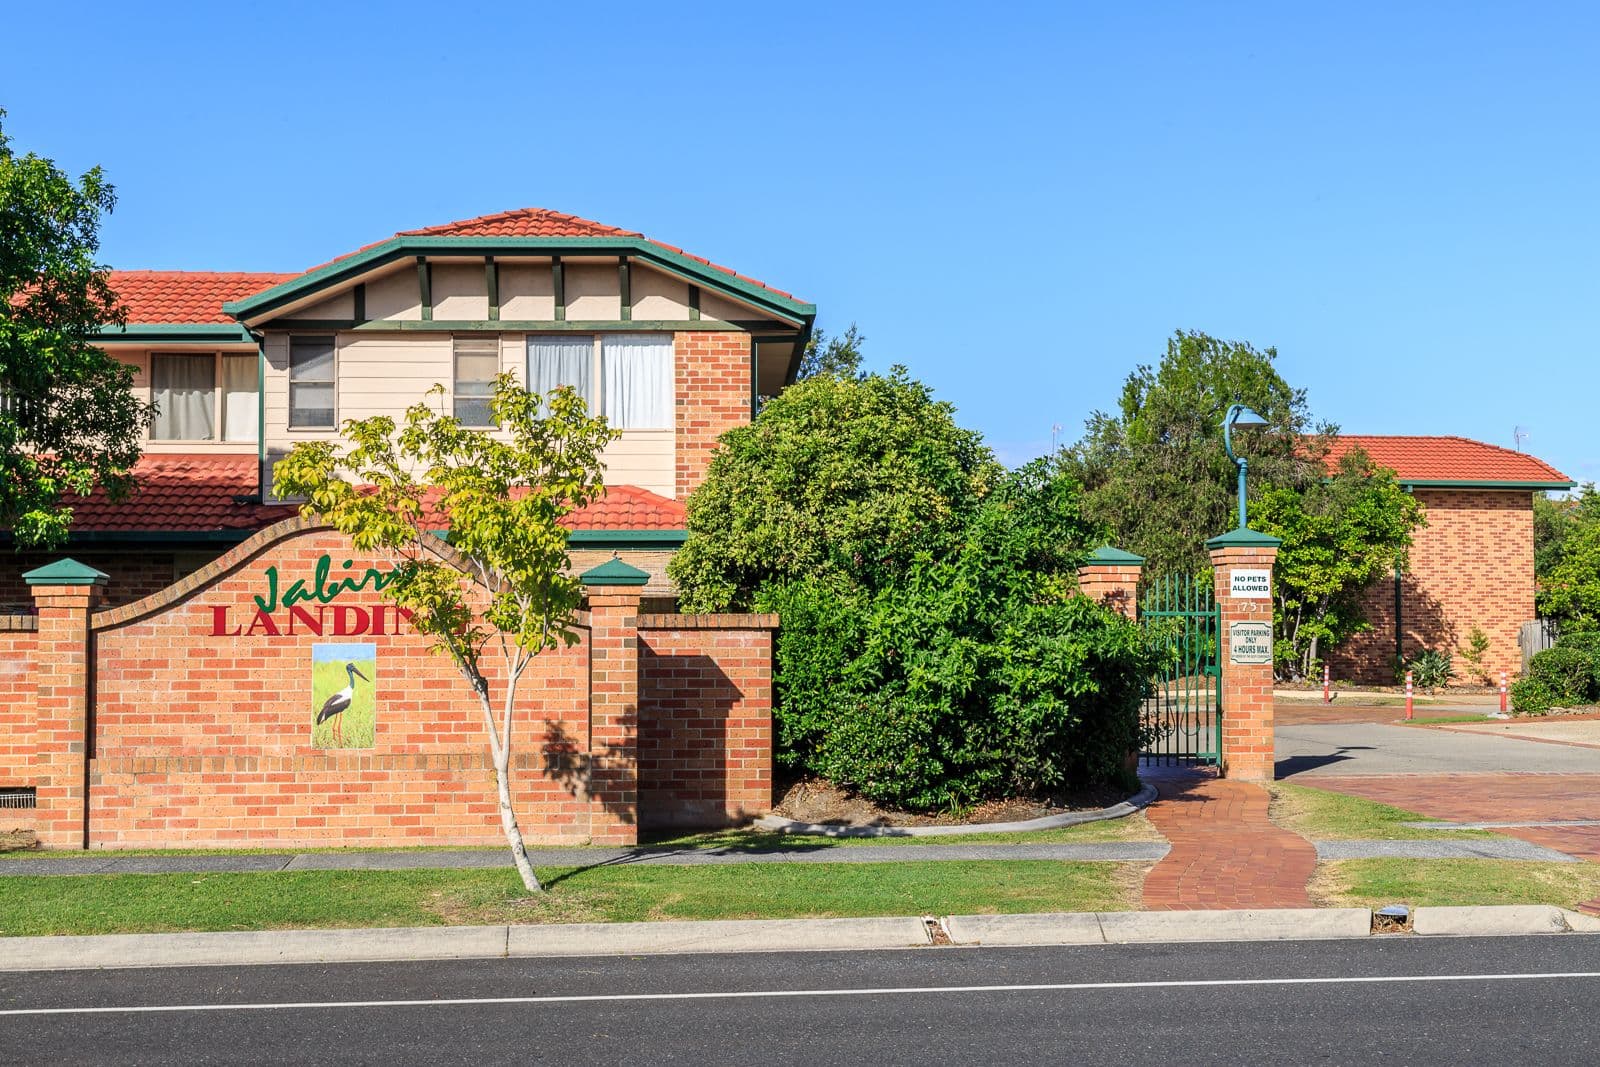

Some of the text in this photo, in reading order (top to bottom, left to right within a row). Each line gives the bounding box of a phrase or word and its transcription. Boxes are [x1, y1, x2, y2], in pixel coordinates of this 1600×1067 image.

[254, 554, 418, 613] Jabir
[1240, 602, 1257, 612] 75
[208, 605, 467, 636] LANDIN
[1250, 629, 1270, 637] PARKING
[1233, 645, 1238, 653] 4
[1238, 645, 1256, 654] HOURS
